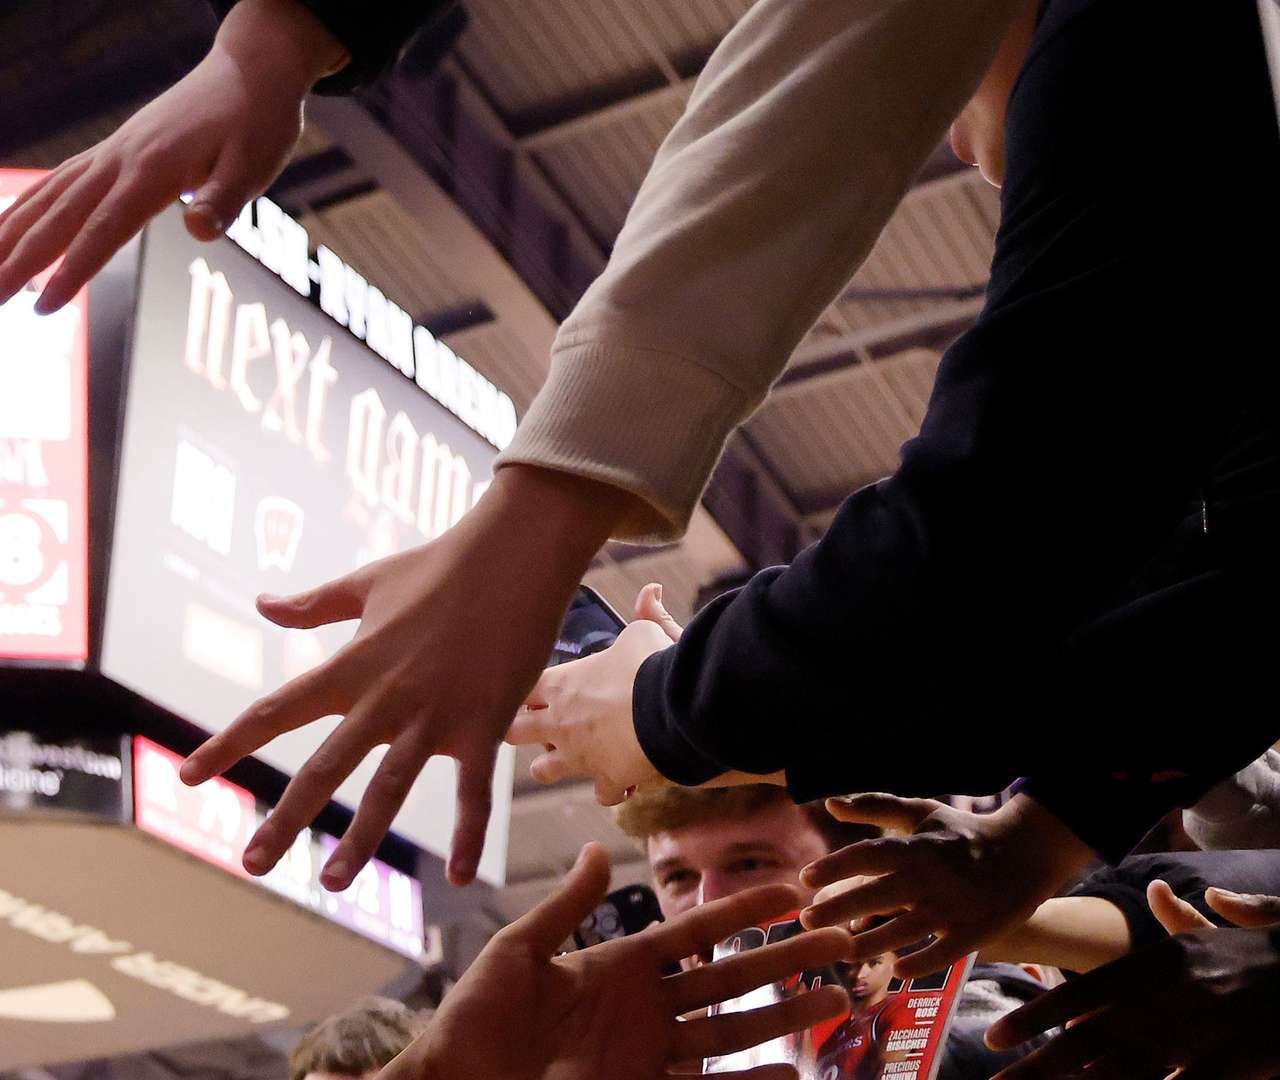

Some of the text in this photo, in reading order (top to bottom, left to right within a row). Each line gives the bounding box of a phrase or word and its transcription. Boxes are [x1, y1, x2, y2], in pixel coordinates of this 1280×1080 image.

[183, 256, 341, 463] next
[907, 996, 943, 1009] DERRICK
[914, 1007, 939, 1019] ROSE
